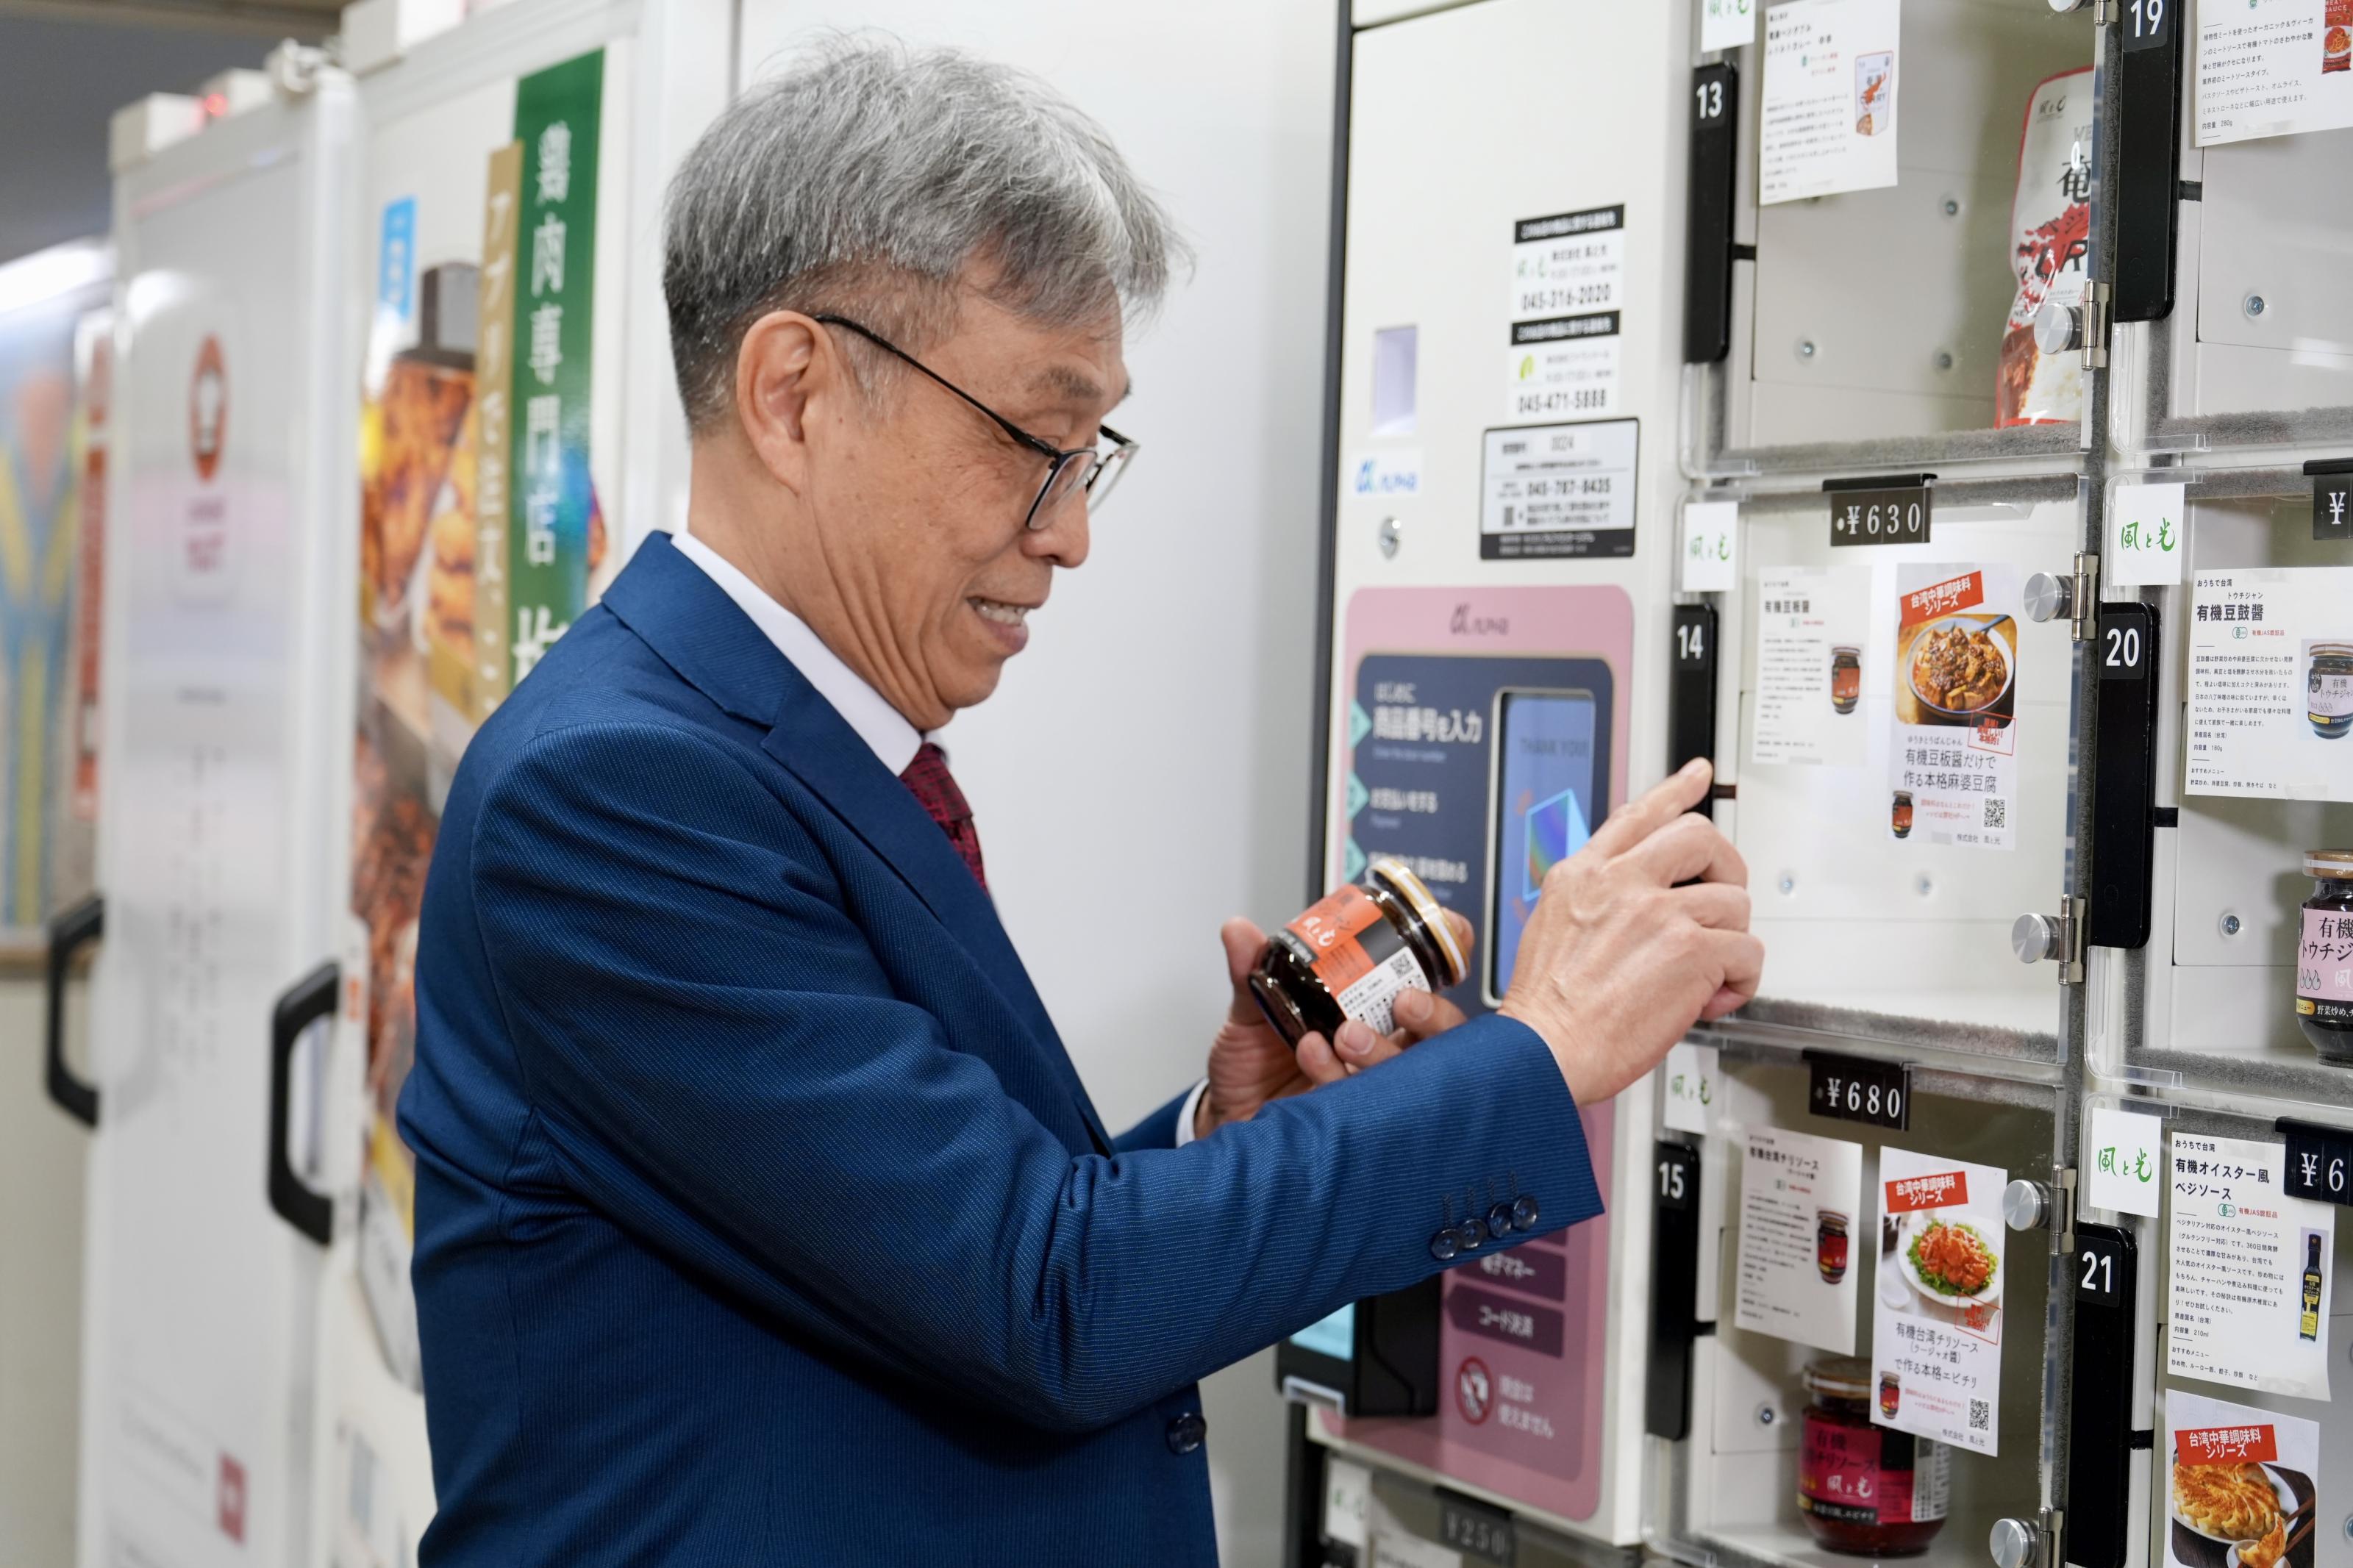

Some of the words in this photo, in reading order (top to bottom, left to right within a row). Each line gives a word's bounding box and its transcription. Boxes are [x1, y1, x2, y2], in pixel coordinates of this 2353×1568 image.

[2130, 0, 2163, 37] 19
[1696, 80, 1723, 119] 13
[2121, 517, 2176, 552] 風と光
[2197, 579, 2232, 587] おうちで台湾
[2227, 591, 2264, 600] トウチジャン
[1677, 624, 1704, 660] 14
[2105, 628, 2140, 667] 20
[2320, 689, 2353, 698] トウチジャ
[1904, 770, 1997, 794] 作る本格麻婆豆腐
[1827, 1077, 1901, 1118] ¥680
[2175, 1139, 2215, 1153] おうちで台湾
[2098, 1146, 2152, 1183] 風と光
[2175, 1157, 2271, 1185] 有機オイスター風
[1658, 1160, 1684, 1200] 15
[2175, 1181, 2232, 1201] ベジソース
[2238, 1207, 2279, 1219] 有機JAS認証品
[2081, 1250, 2112, 1294] 21
[1896, 1322, 1979, 1353] 有機台湾チリソース
[2174, 1325, 2189, 1335] 内容量
[2193, 1329, 2210, 1339] 210ml
[1895, 1358, 1977, 1389] で作る本格エビチリ
[2188, 1428, 2262, 1447] 台湾中華調味料
[2206, 1442, 2247, 1460] シリーズ
